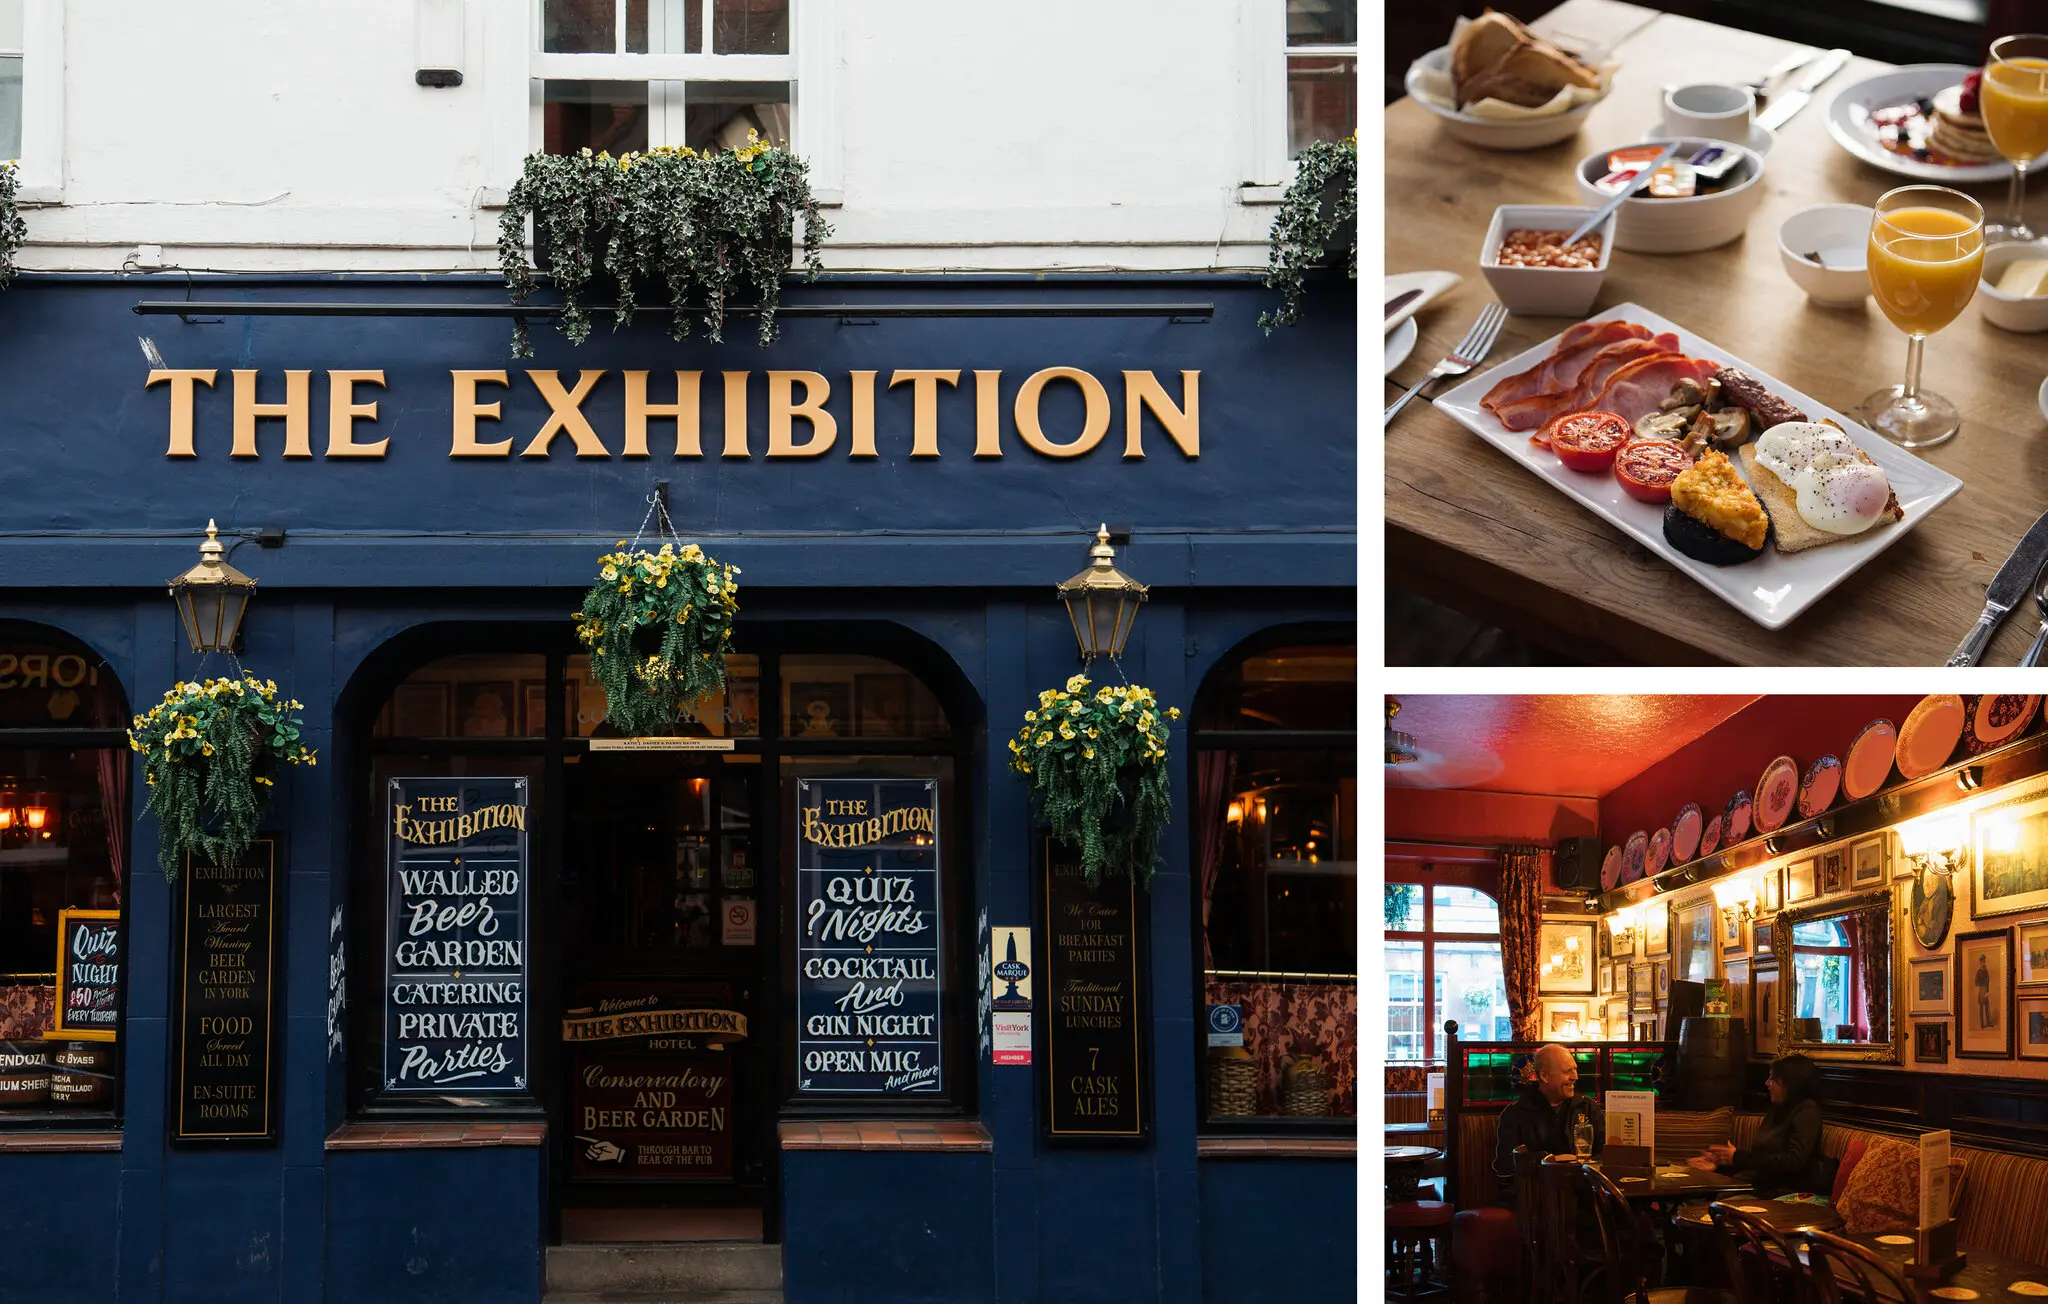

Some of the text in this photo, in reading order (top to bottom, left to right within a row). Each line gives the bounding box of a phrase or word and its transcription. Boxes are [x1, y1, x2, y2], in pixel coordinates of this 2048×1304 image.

[144, 366, 1202, 457] THE EXHIBITION
[417, 796, 459, 812] THE
[826, 798, 868, 816] THE
[394, 804, 526, 844] EXHIBITION
[802, 806, 935, 848] EXHIBITION
[196, 868, 264, 880] EXHIBITION
[398, 870, 520, 896] WALLED
[826, 876, 916, 905] QUIZ
[198, 904, 260, 918] LARGEST
[407, 897, 499, 936] Beer
[208, 920, 248, 933] Award
[1081, 920, 1100, 930] FOR
[74, 924, 117, 960] Quiz
[204, 934, 251, 952] Winning
[1058, 934, 1124, 946] BREAKFAST
[210, 954, 245, 968] BEER
[395, 940, 523, 967] GARDEN
[1069, 951, 1116, 962] PARTIES
[198, 970, 256, 984] GARDEN
[804, 956, 936, 980] COCKTAIL
[204, 988, 250, 999] IN YORK
[392, 982, 522, 1005] CATERING
[1064, 979, 1122, 992] Traditional
[70, 987, 92, 1006] £50
[599, 994, 658, 1012] Welcome to
[834, 979, 904, 1012] And
[1062, 996, 1124, 1012] SUNDAY
[68, 1008, 90, 1022] EVERY
[1066, 1016, 1122, 1028] LUNCHES
[200, 1017, 252, 1035] FOOD
[398, 1012, 518, 1039] PRIVATE
[568, 1012, 738, 1040] THE EXHIBITION
[806, 1014, 934, 1036] GIN NIGHT
[206, 1038, 244, 1052] Served
[649, 1039, 697, 1050] HOTEL
[67, 1054, 94, 1064] BYASS
[200, 1054, 252, 1067] ALL DAY
[400, 1040, 514, 1081] Parties
[804, 1051, 921, 1072] OPEN MIC
[1088, 1048, 1100, 1072] 7
[583, 1064, 726, 1098] Conservatory
[884, 1064, 939, 1090] And more
[1071, 1076, 1118, 1094] CASK
[193, 1086, 256, 1099] EN-SUITE
[634, 1092, 676, 1108] AND
[200, 1104, 248, 1118] ROOMS
[1074, 1097, 1118, 1115] ALES
[584, 1106, 725, 1132] BEER GARDEN
[638, 1145, 712, 1155] THROUGH BAR TO
[638, 1155, 713, 1165] REAR OF THE PUB
